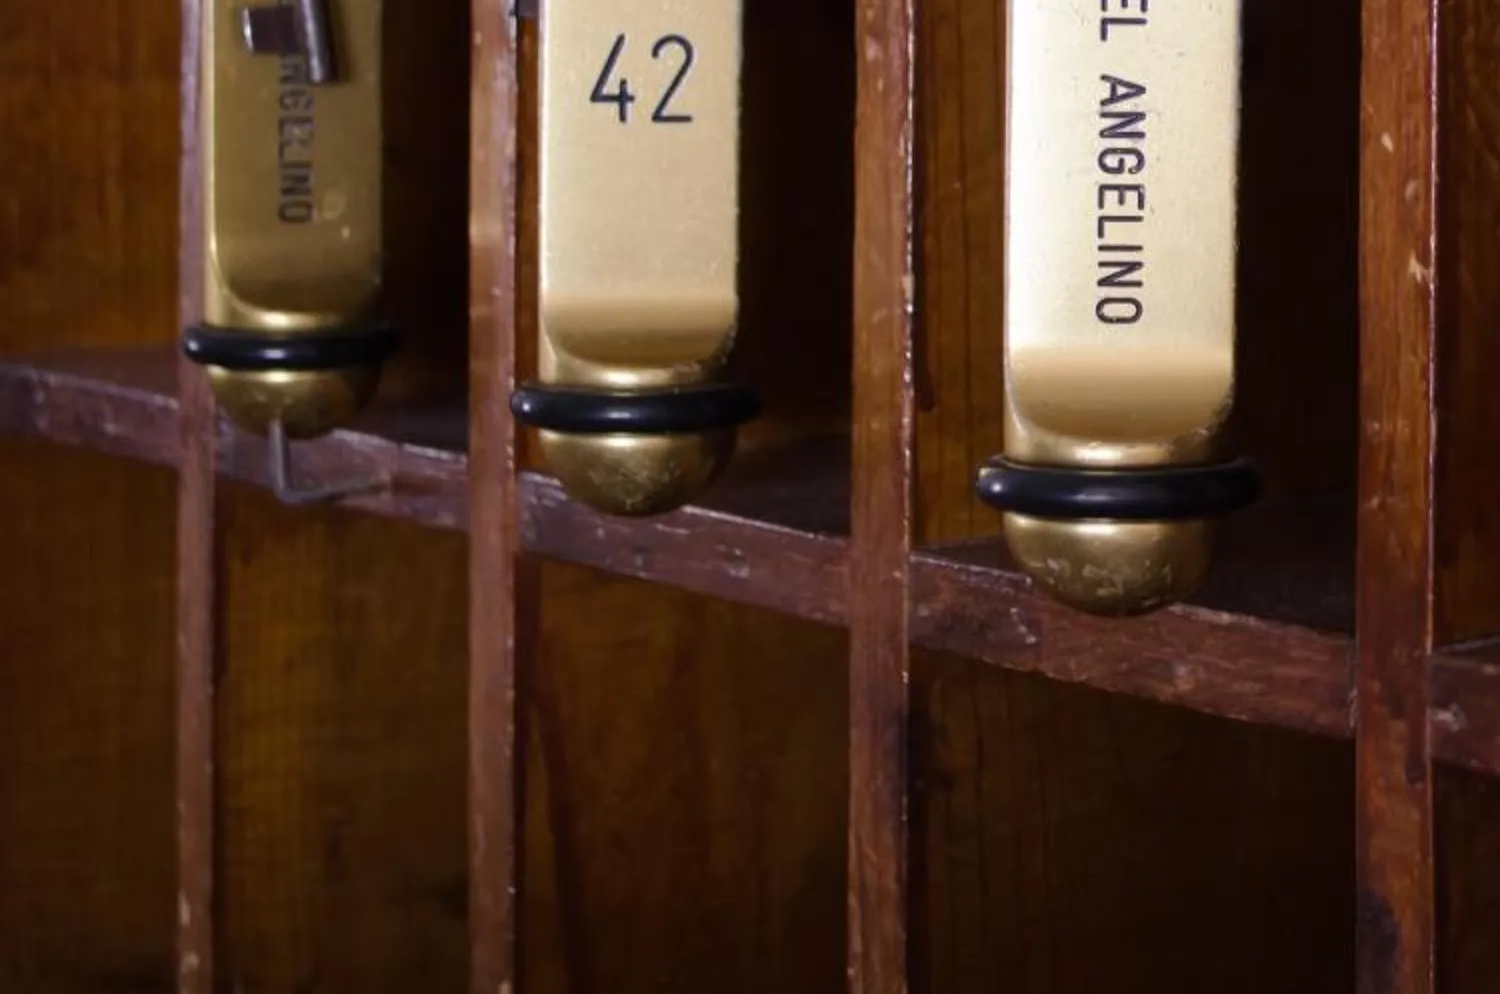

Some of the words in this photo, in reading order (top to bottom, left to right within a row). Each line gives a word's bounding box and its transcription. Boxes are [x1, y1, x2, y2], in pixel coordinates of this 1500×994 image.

[278, 53, 315, 224] NGELINO
[589, 33, 694, 123] 42
[1095, 73, 1147, 325] ANGELINO
